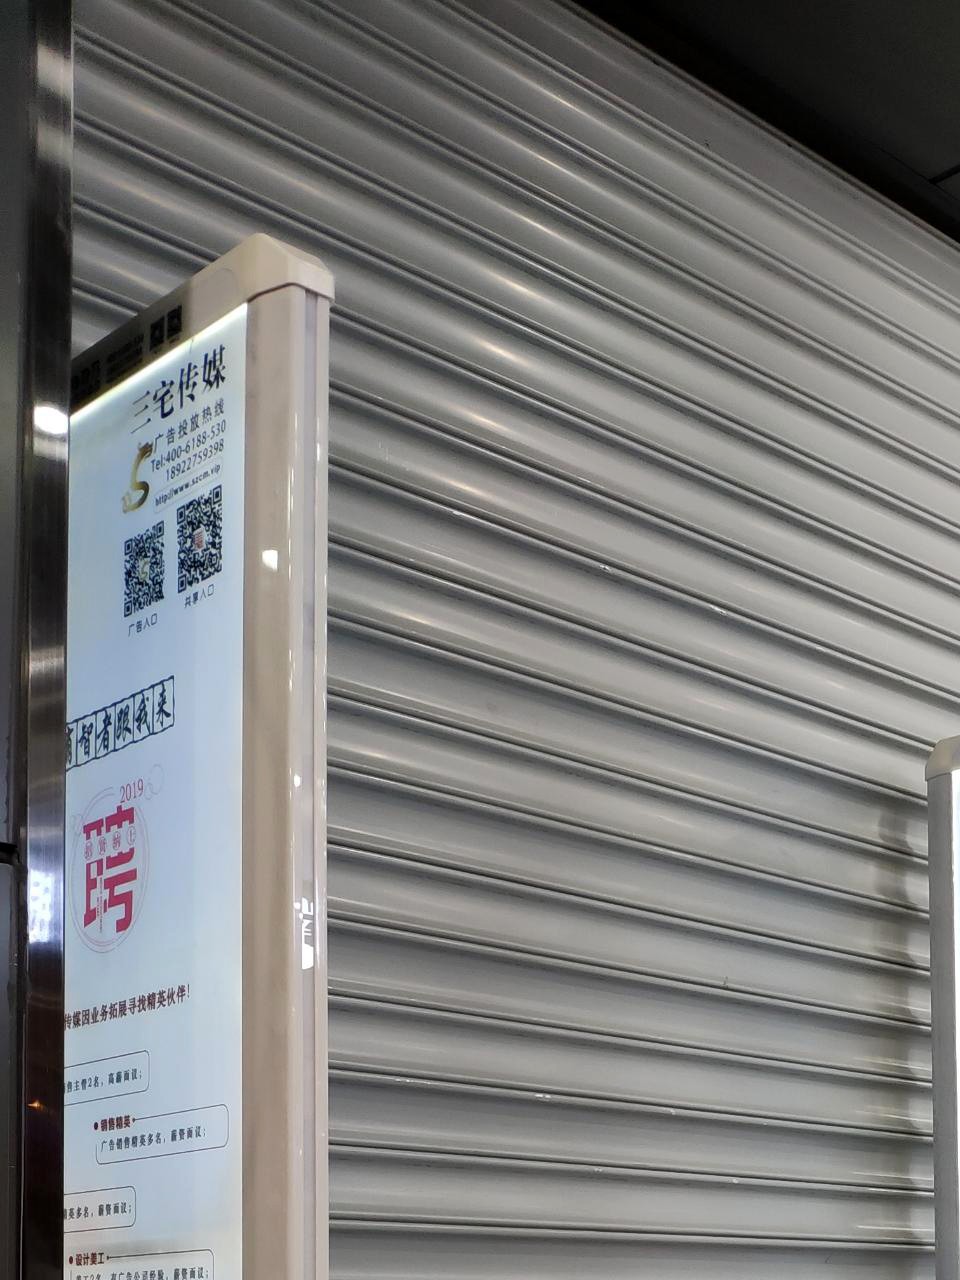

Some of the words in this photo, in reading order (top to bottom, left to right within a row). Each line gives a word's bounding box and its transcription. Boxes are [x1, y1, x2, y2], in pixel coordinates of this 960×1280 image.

[130, 344, 228, 434] 三宅传媒
[151, 419, 226, 472] Tel:400-6188-530
[153, 398, 225, 453] 广告投放热线
[165, 438, 225, 481] 18922759398
[183, 584, 216, 609] 共享入口
[127, 612, 159, 637] 广告入口
[119, 778, 144, 804] 2019
[83, 805, 137, 934] 聘
